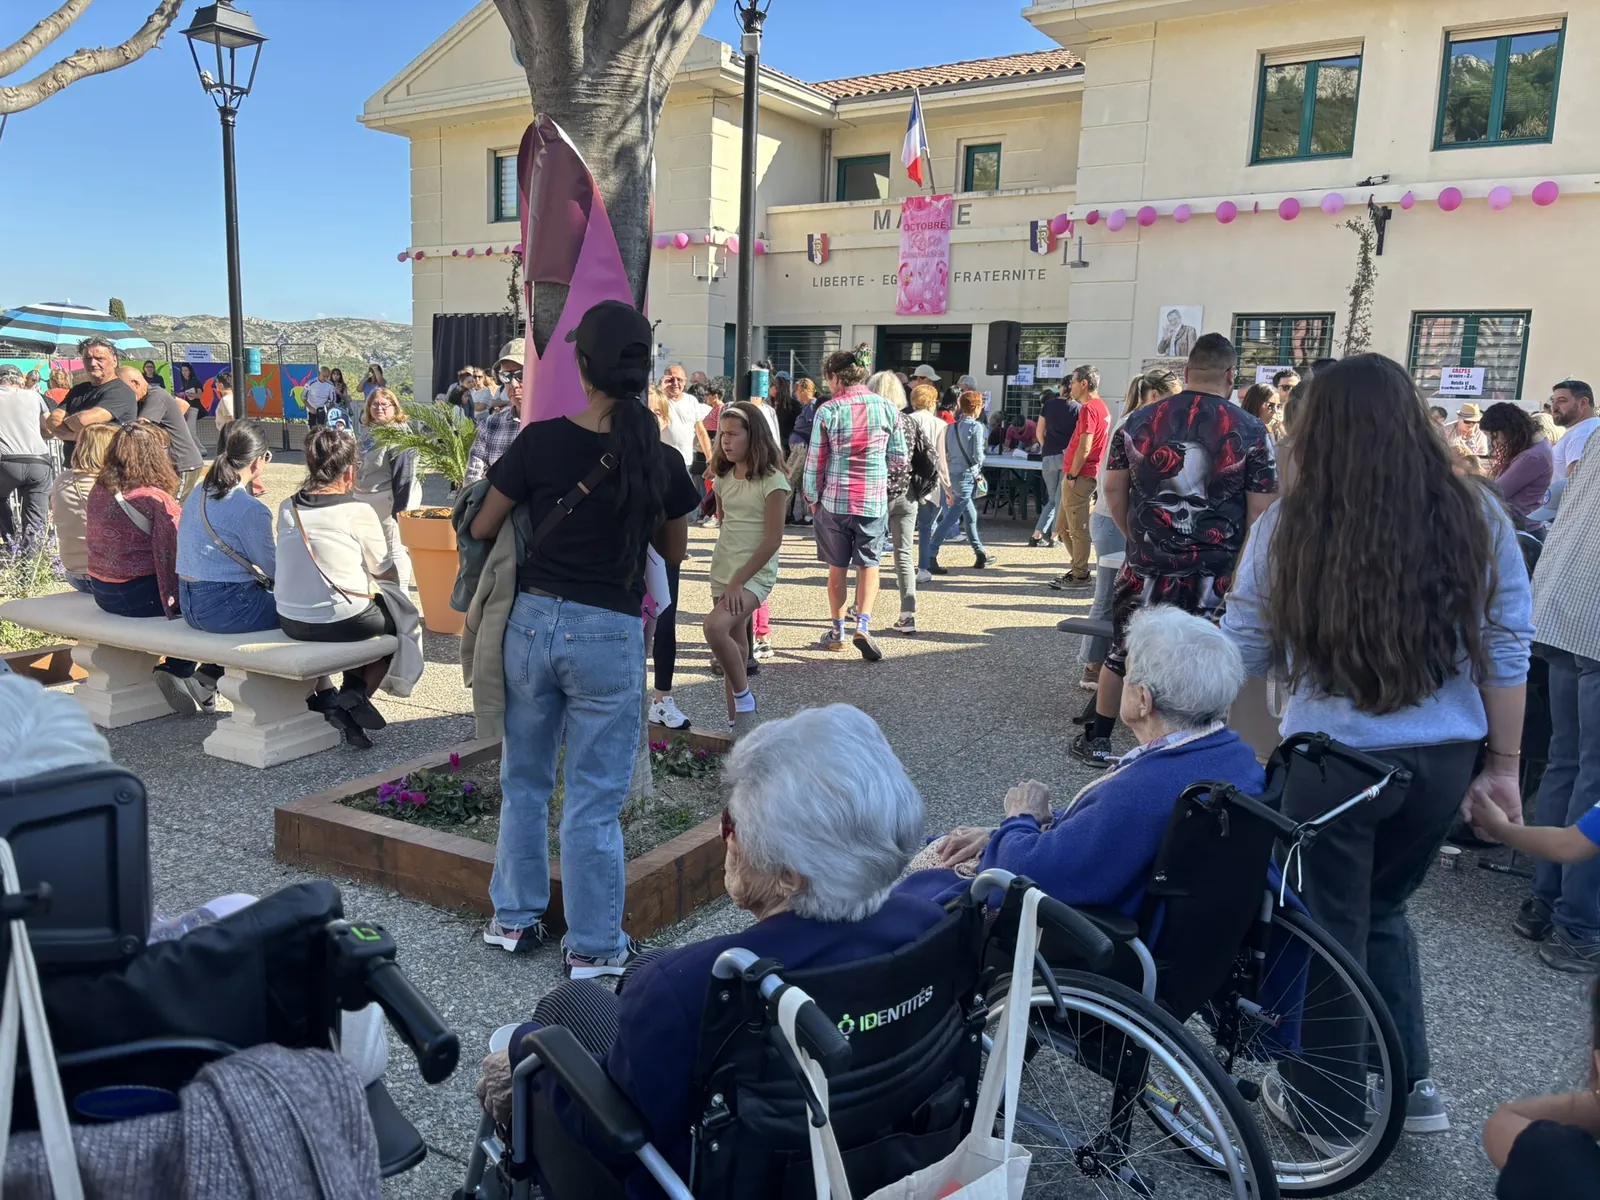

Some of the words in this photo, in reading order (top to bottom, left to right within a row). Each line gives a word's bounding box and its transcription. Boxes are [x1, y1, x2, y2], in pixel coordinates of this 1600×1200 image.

[903, 220, 947, 232] OCTOBRE
[812, 275, 865, 288] LIBERTE
[953, 268, 1047, 283] FRATERNITE
[859, 985, 933, 1032] IDENTITÉS
